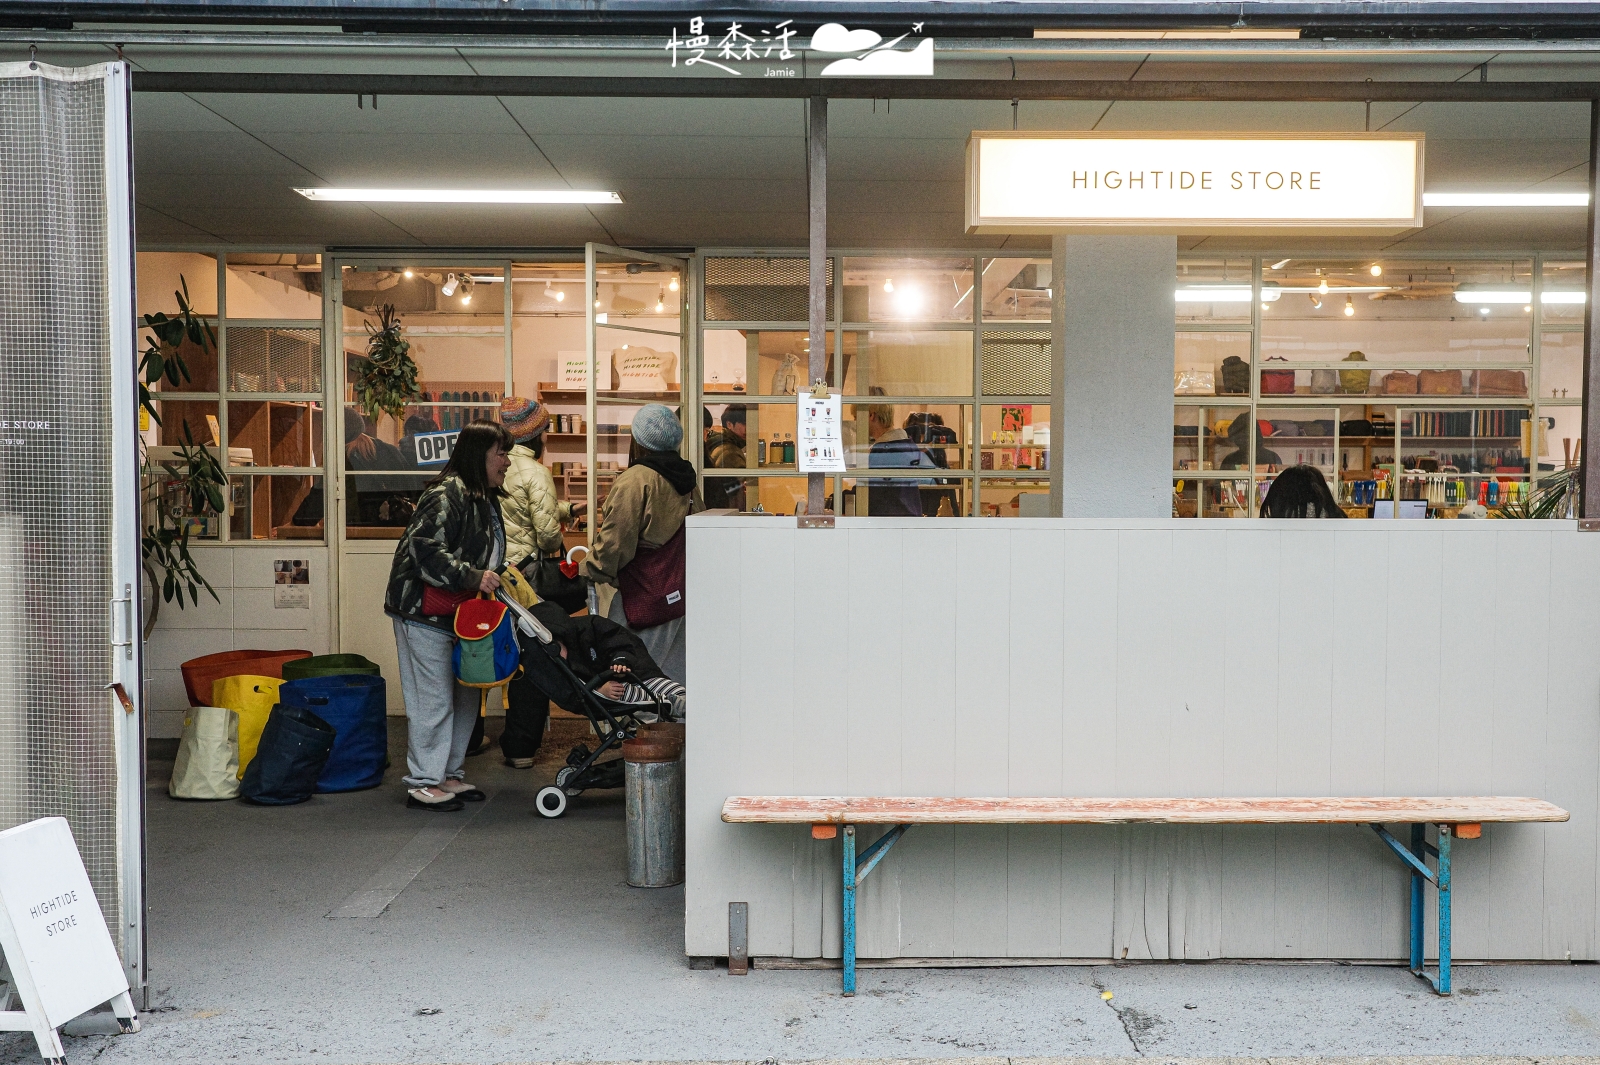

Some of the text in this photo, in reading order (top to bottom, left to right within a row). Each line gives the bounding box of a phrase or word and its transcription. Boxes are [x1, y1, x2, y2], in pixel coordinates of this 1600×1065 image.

[1073, 170, 1321, 190] HIGHTIDE STORE
[0, 420, 50, 429] E STORE
[418, 434, 458, 461] OPE
[29, 890, 78, 919] HIGHTIDE
[46, 914, 77, 936] STORE
